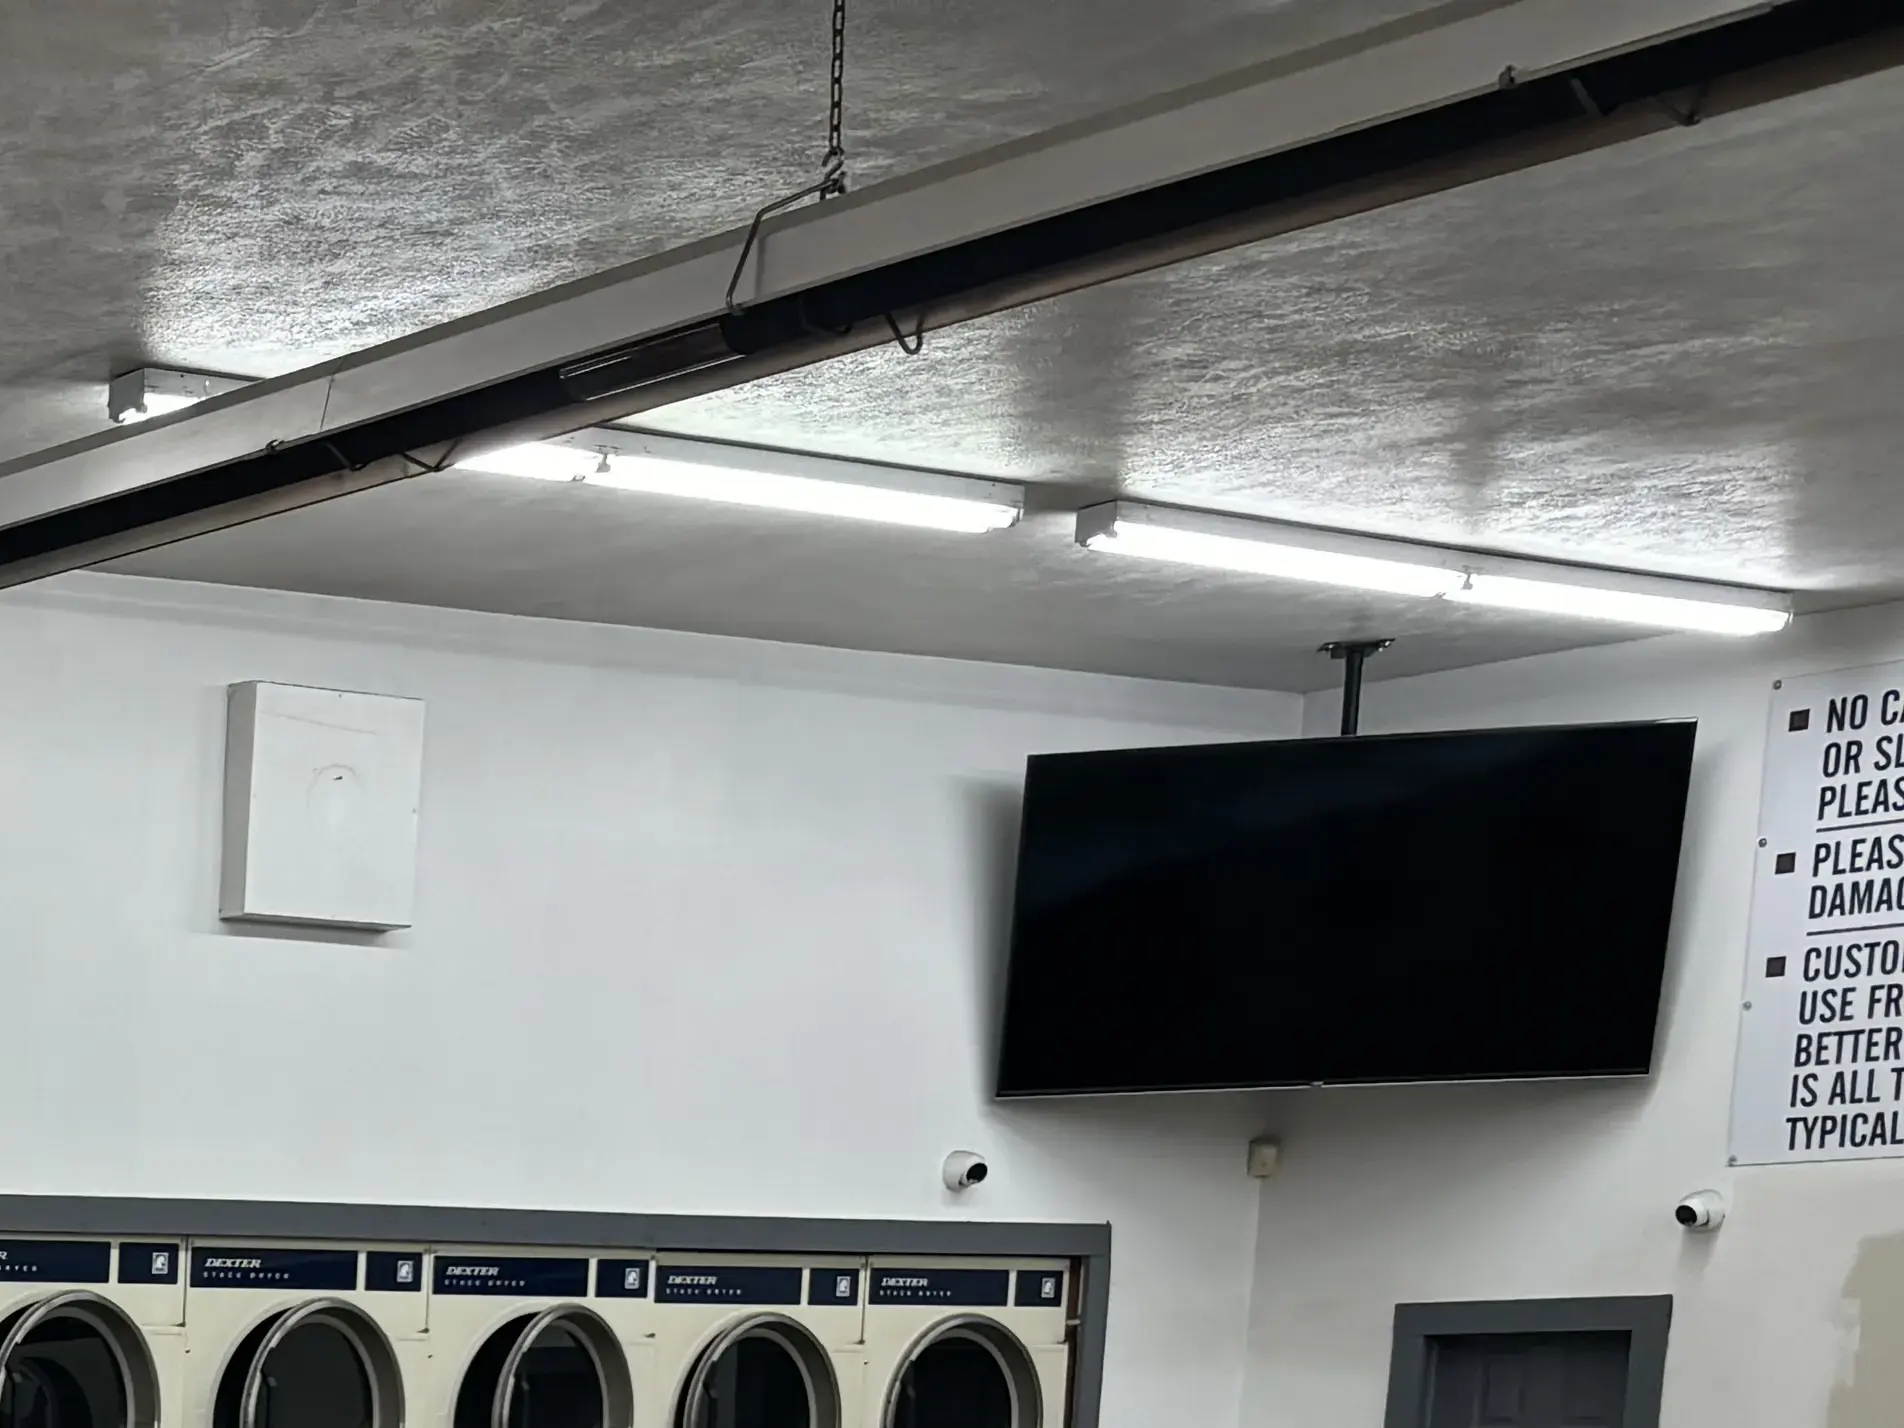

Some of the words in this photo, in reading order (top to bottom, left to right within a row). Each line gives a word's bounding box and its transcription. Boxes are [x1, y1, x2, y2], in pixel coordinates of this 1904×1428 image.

[1826, 693, 1869, 733] NO
[1880, 689, 1904, 726] C
[1822, 739, 1863, 778] OR
[1817, 775, 1904, 821] PLEAS
[1812, 833, 1904, 878] PLEAS
[1802, 939, 1904, 982] CUSTO
[1798, 986, 1857, 1025] USE
[1867, 983, 1903, 1020] FR
[1794, 1026, 1903, 1068] BETTER
[1789, 1072, 1819, 1108] IS
[1827, 1068, 1881, 1106] ALL
[1785, 1110, 1904, 1151] TYPICAL
[204, 1258, 262, 1268] DEXTER
[446, 1266, 499, 1276] DEXTER
[667, 1276, 718, 1285] DEXTER
[881, 1277, 929, 1287] DEXTER
